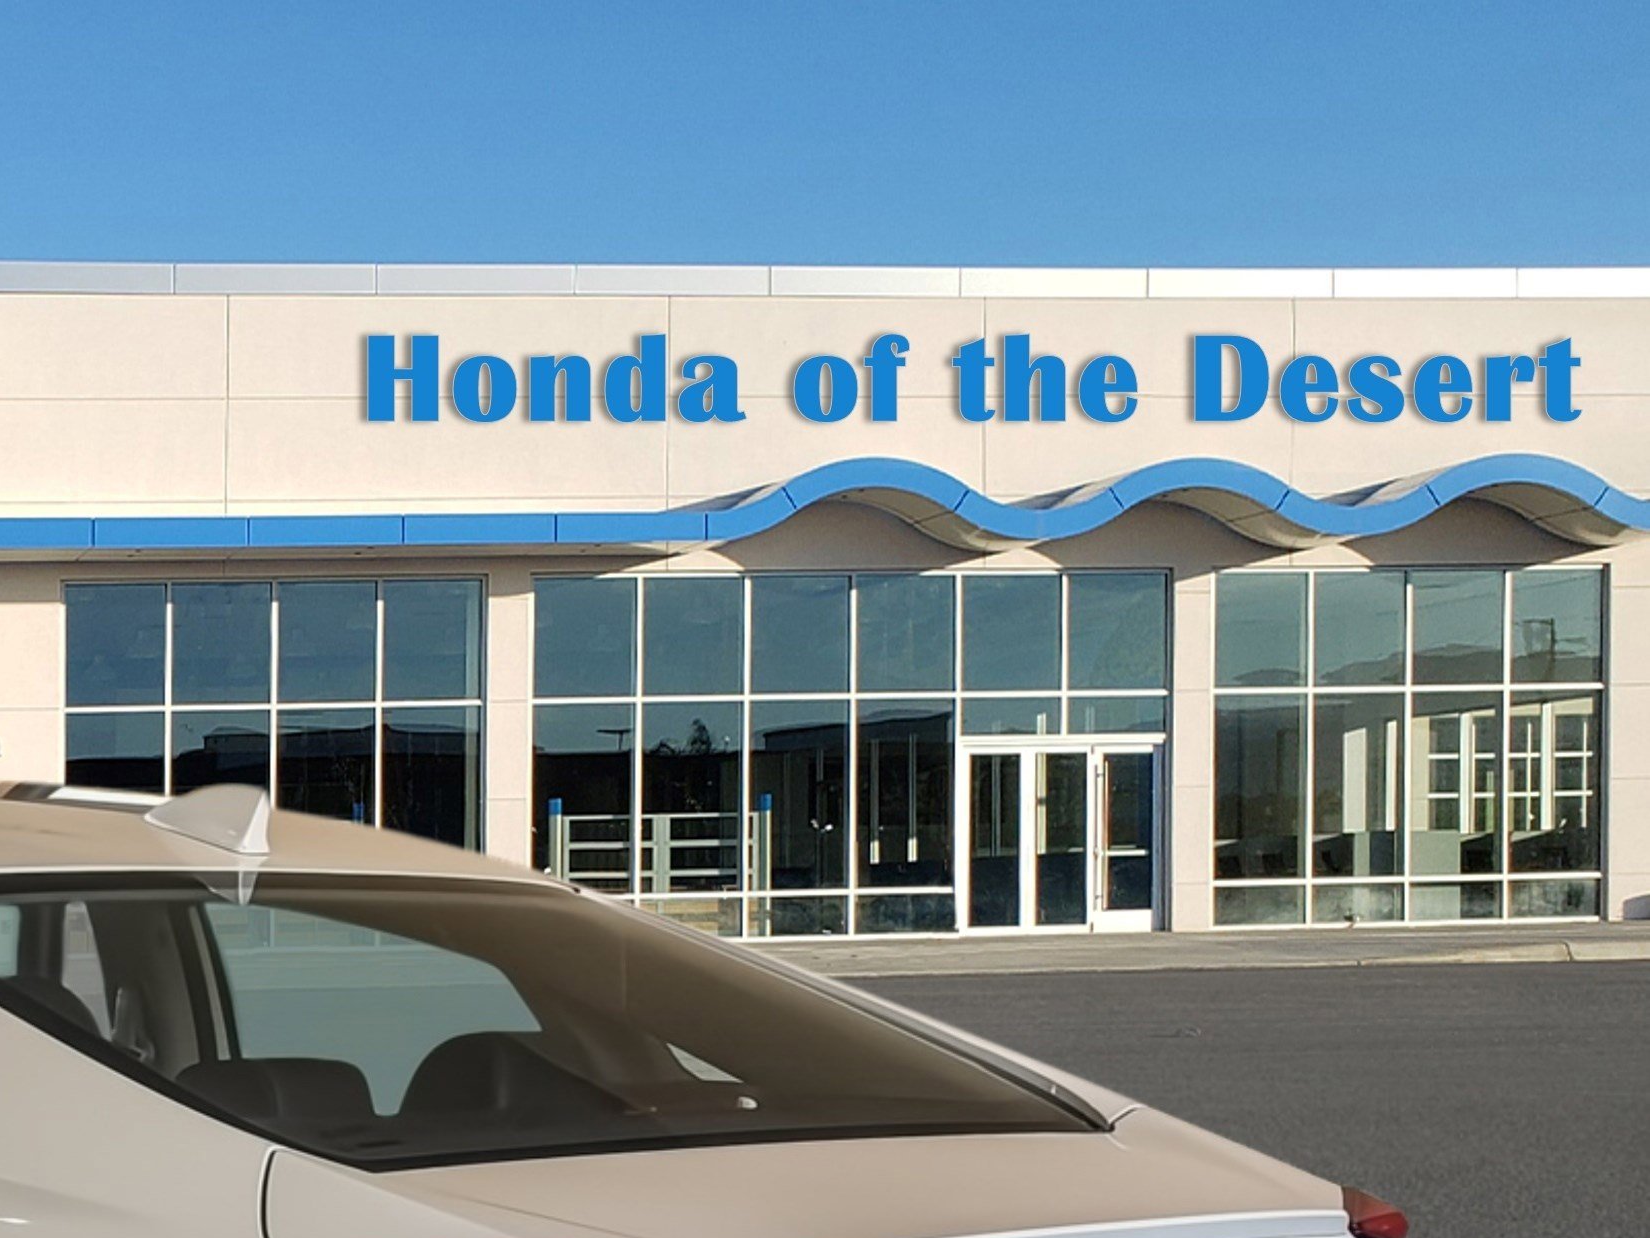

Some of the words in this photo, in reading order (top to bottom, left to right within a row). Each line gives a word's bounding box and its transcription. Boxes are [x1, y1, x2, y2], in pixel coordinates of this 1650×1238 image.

[367, 334, 747, 423] Honda
[793, 334, 911, 423] of
[952, 334, 1138, 423] the
[1195, 335, 1582, 423] Desert
